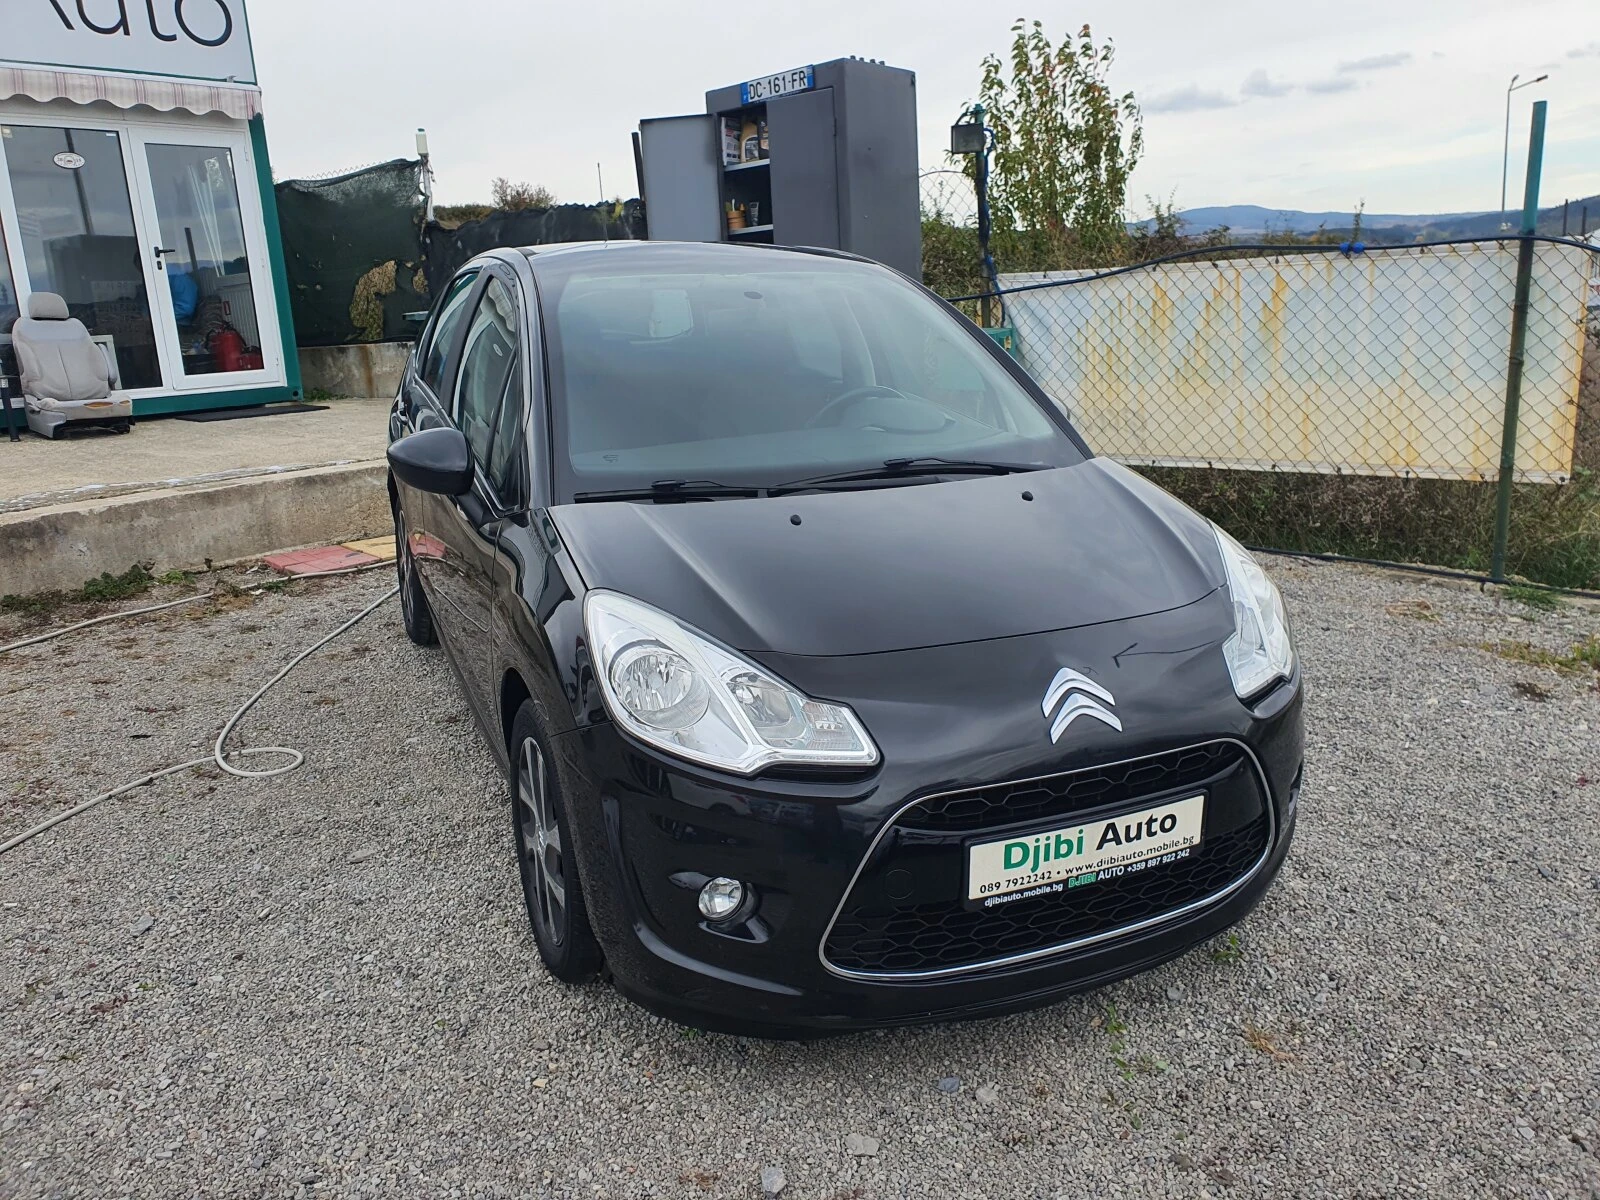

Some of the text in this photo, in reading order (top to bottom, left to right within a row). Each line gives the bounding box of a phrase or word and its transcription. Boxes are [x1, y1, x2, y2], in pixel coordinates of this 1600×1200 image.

[749, 70, 806, 100] DC-161-FR
[1003, 813, 1177, 873] Djibi Auto
[979, 882, 1001, 894] 089
[1005, 870, 1053, 889] 7922242
[984, 883, 1063, 907] djibiauto.mobile.bg
[1098, 867, 1124, 880] AUTO
[1127, 863, 1145, 872] +359
[1162, 854, 1175, 864] 922
[1177, 849, 1190, 859] 242
